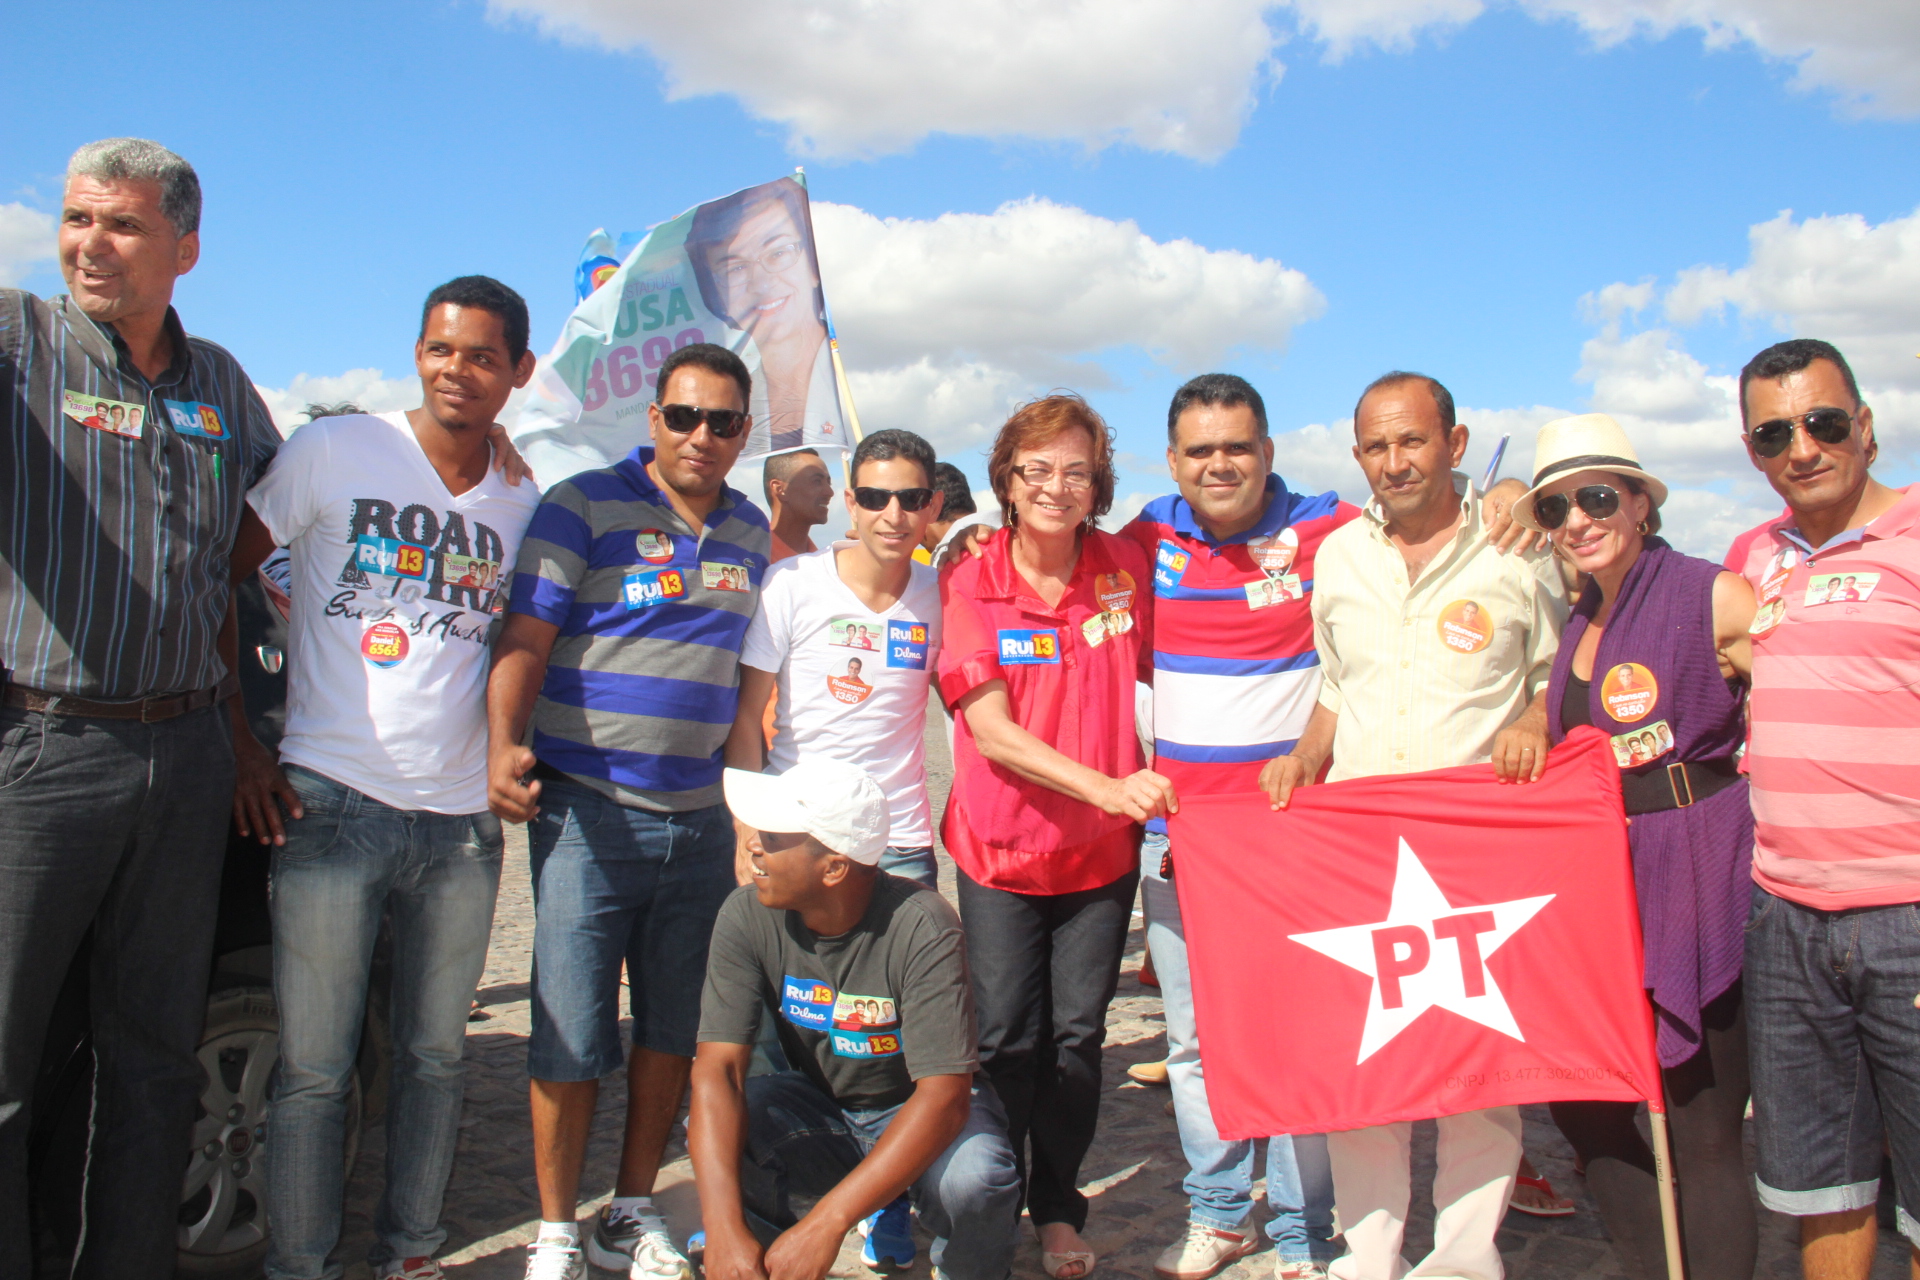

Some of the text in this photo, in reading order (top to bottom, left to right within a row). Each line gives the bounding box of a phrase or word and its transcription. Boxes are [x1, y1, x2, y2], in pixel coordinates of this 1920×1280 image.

[623, 271, 680, 300] STADUAL
[69, 402, 94, 413] 13690
[347, 498, 504, 563] ROAD
[1253, 547, 1292, 555] Robinson
[1258, 558, 1285, 567] 1350
[1100, 589, 1133, 601] Robinson
[1443, 621, 1484, 641] Robinson
[370, 635, 394, 646] Daniel
[1446, 635, 1474, 652] 1350
[368, 644, 399, 657] 6565
[893, 646, 922, 660] Dilma
[831, 678, 867, 693] Robinson
[834, 690, 859, 704] 1350
[1608, 691, 1650, 704] Robinson
[1615, 703, 1645, 717] 1350
[1370, 910, 1497, 1011] PT
[789, 1004, 826, 1021] Dilma
